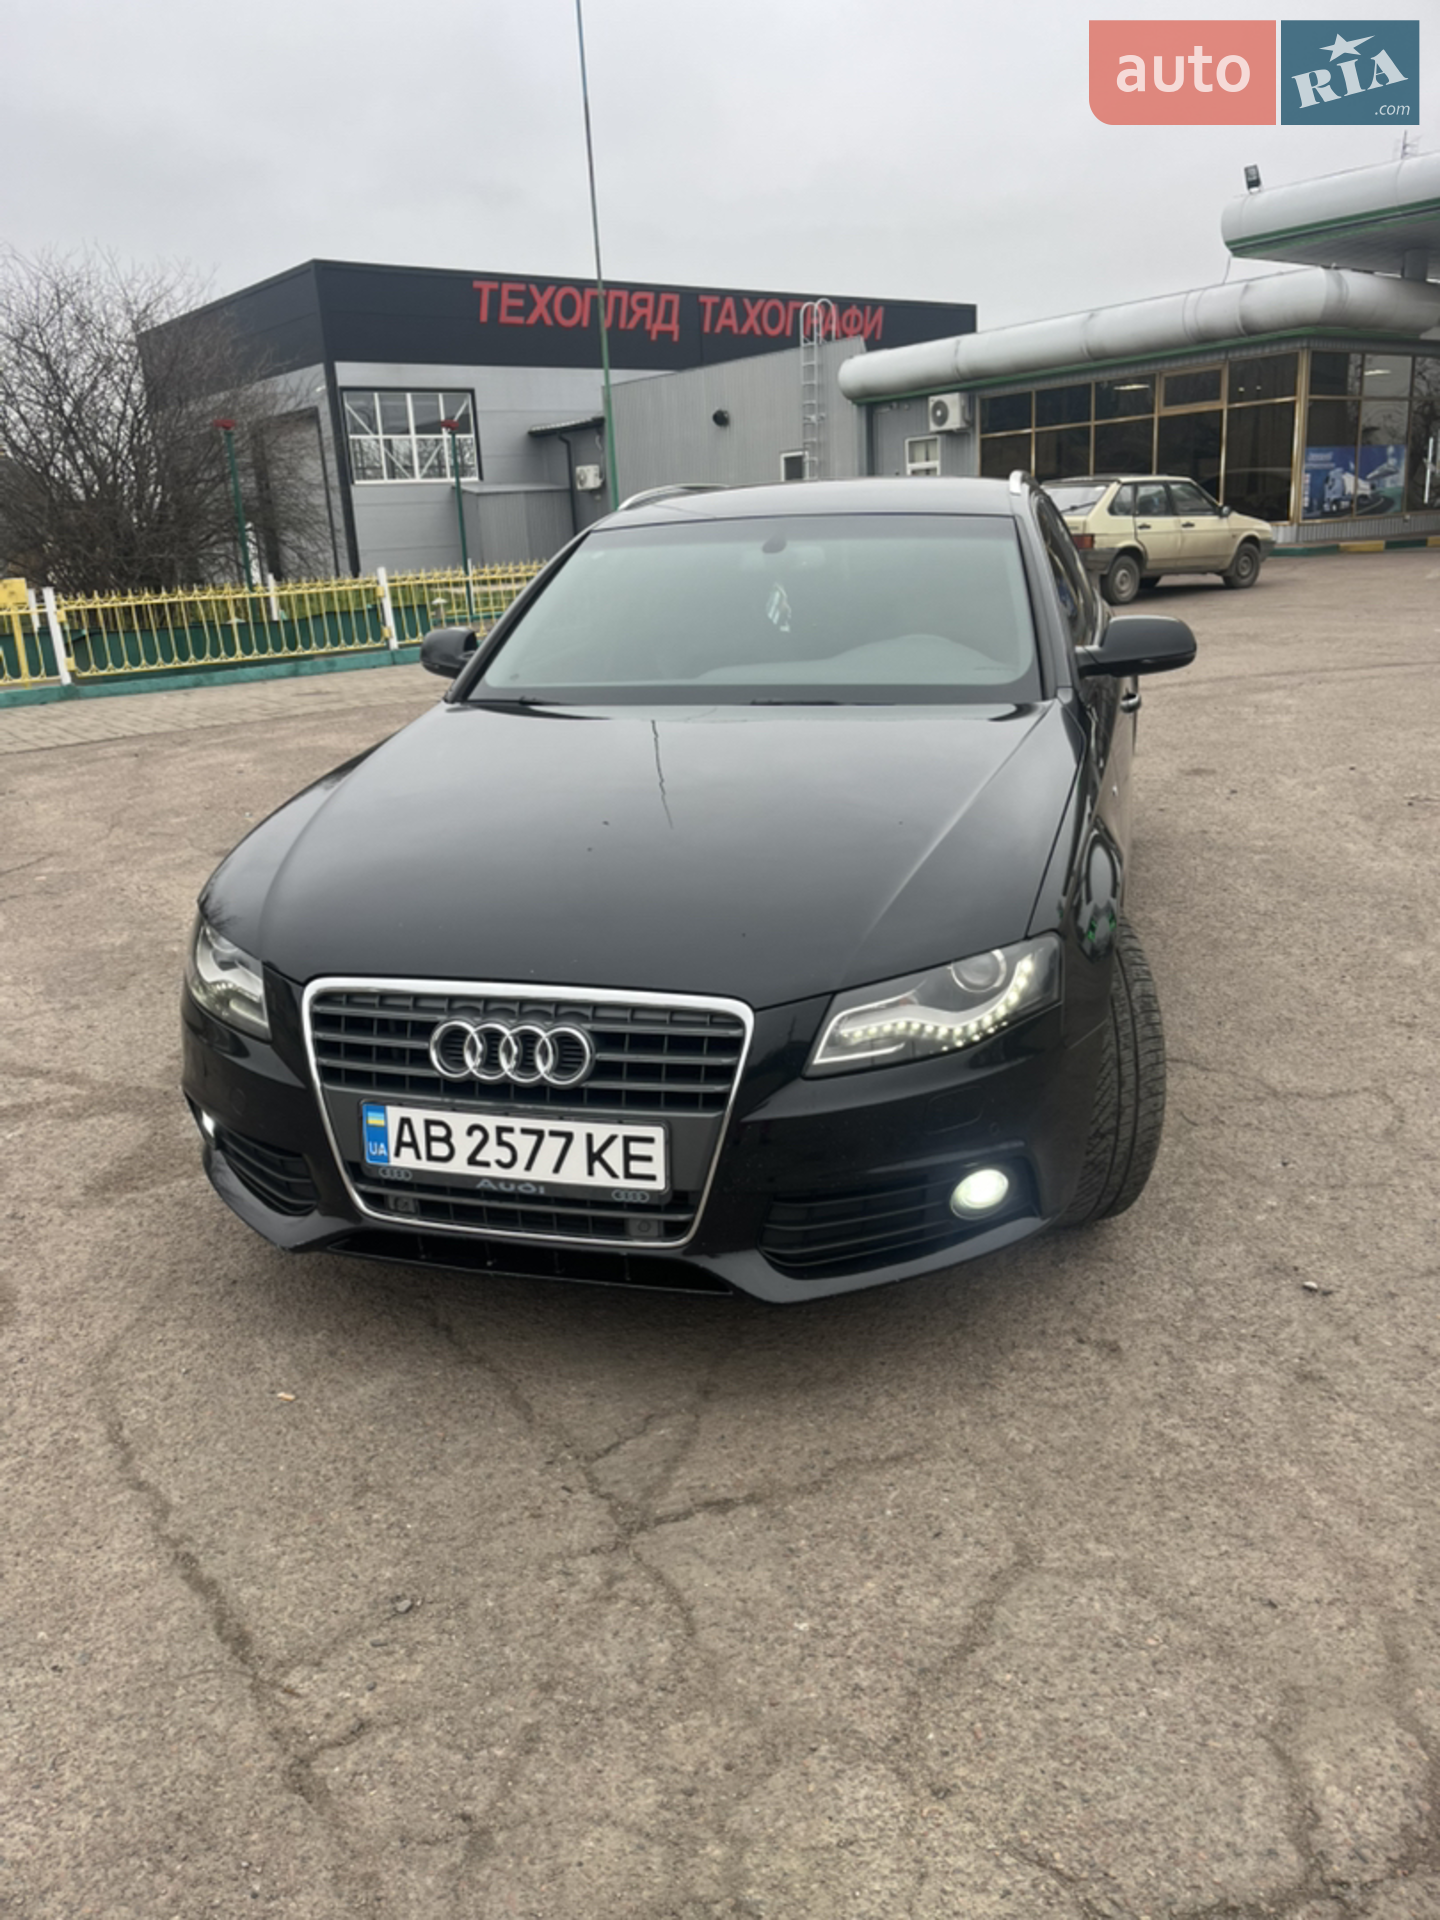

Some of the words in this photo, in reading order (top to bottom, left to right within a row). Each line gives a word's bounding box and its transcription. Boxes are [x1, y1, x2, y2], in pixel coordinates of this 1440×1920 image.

[472, 280, 680, 342] ТЕХОГЛЯД
[368, 1141, 388, 1157] UA
[394, 1116, 456, 1164] AB
[465, 1123, 574, 1175] 2577
[586, 1132, 657, 1182] KE
